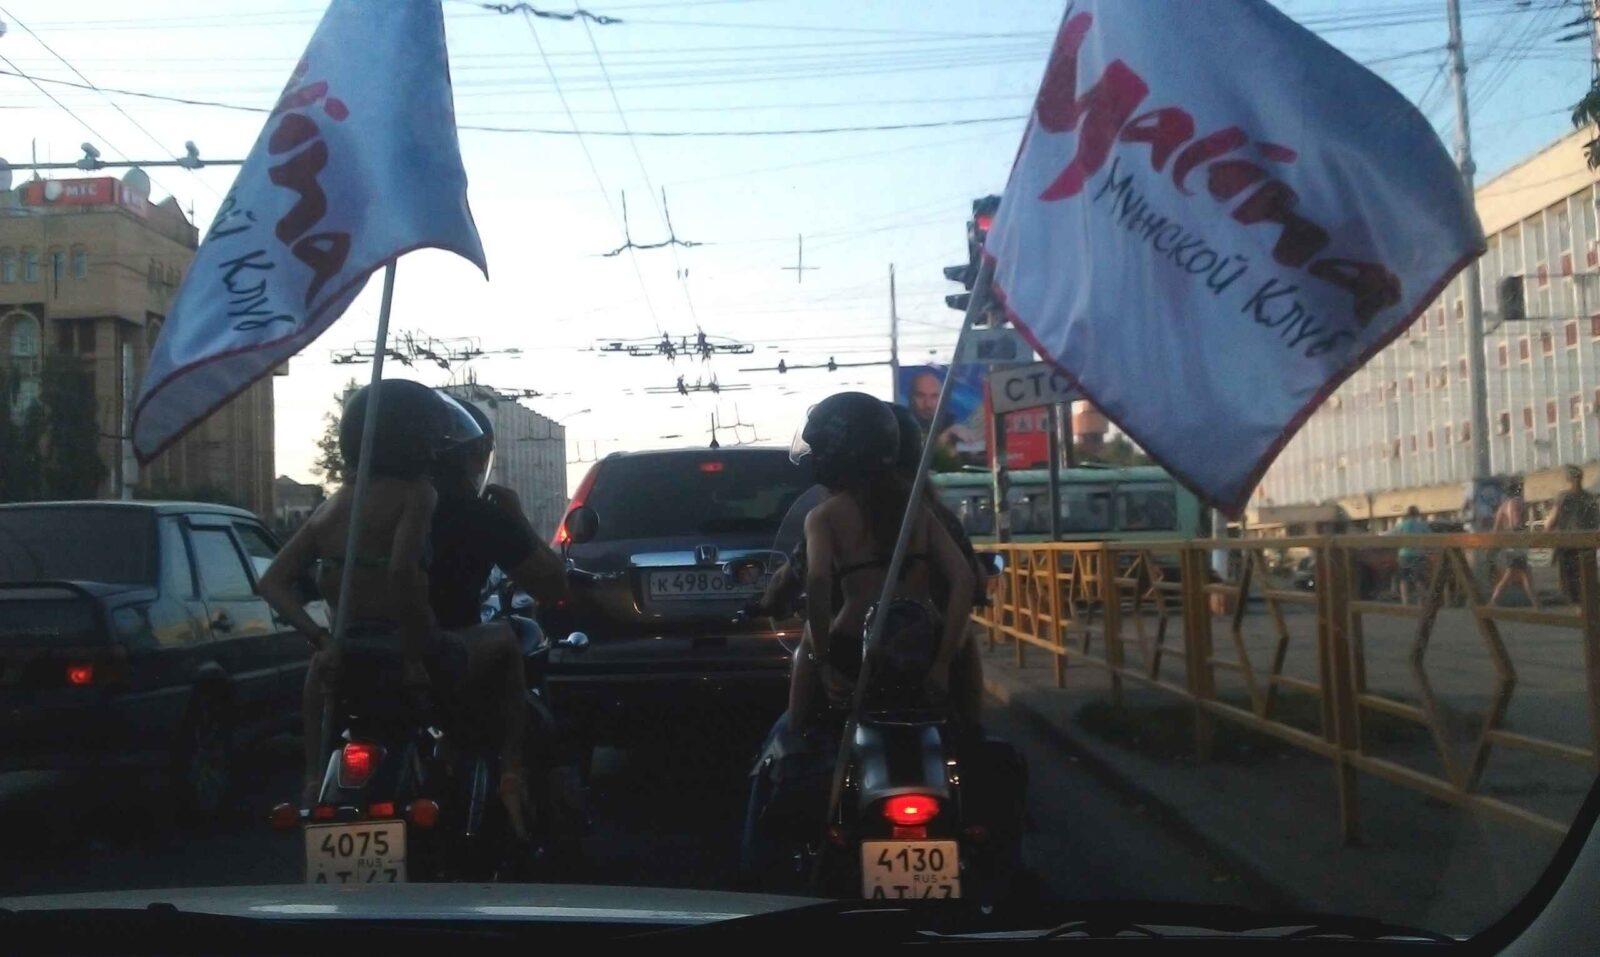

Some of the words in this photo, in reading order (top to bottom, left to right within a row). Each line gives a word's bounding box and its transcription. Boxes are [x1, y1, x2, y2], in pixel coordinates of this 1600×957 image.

[320, 830, 390, 858] 4075
[876, 847, 944, 873] 4130
[913, 874, 938, 883] RUS
